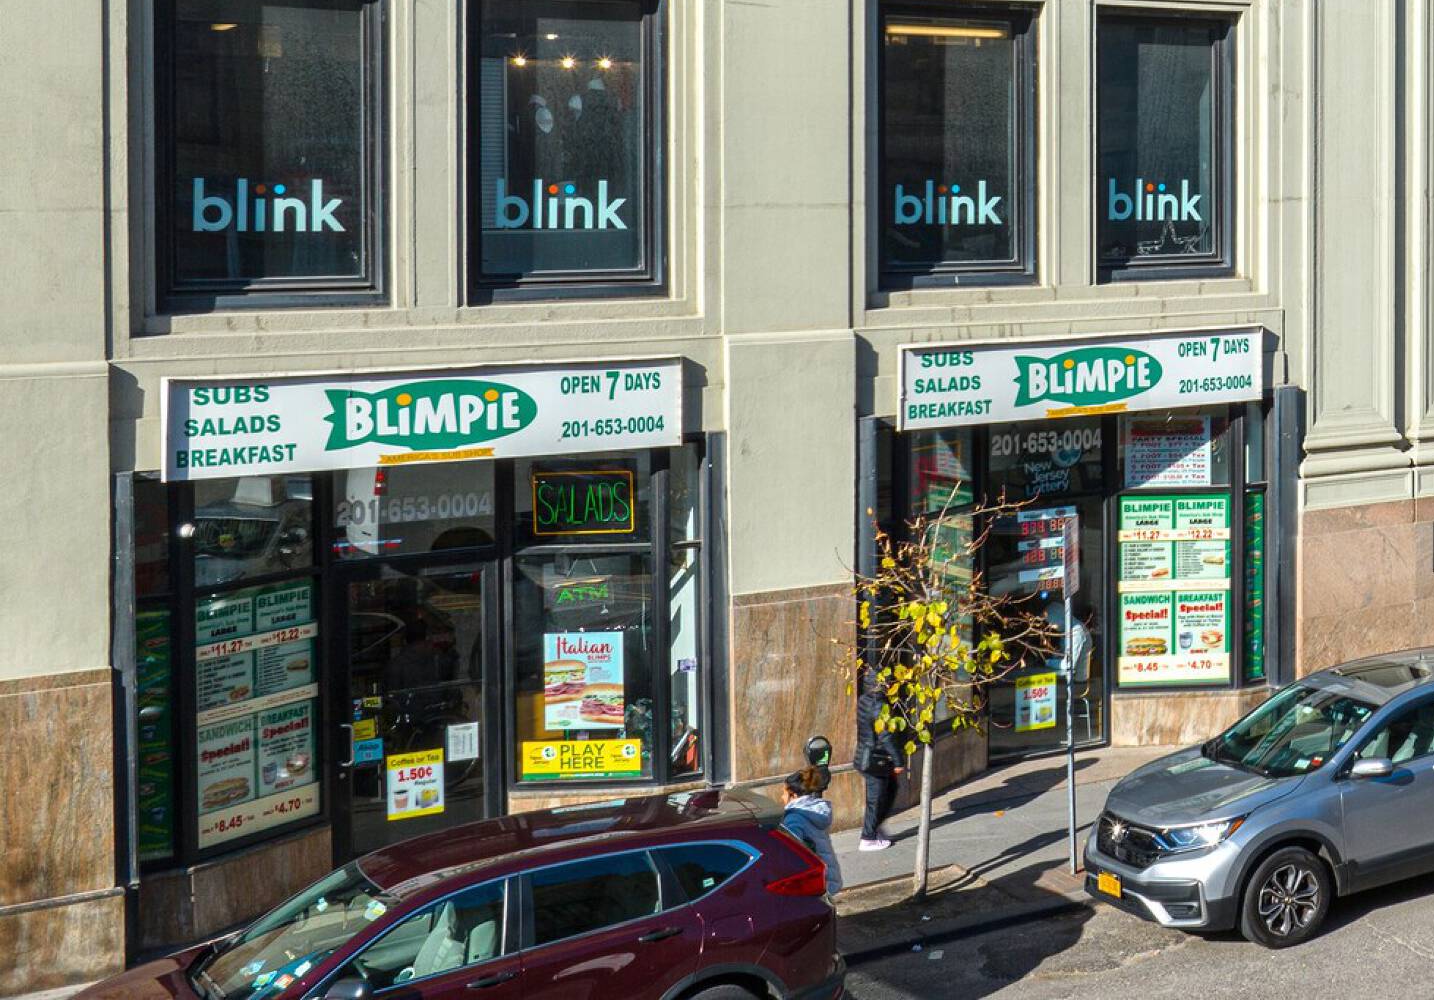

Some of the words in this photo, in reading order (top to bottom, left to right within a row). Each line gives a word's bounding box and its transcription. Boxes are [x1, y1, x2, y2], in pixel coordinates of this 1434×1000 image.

[191, 177, 347, 233] blink
[494, 178, 628, 229] blink
[894, 179, 1003, 225] blink
[1107, 177, 1202, 222] blink
[921, 350, 974, 368] SUBS
[1178, 341, 1207, 358] OPEN
[1210, 337, 1221, 362] 7
[1224, 338, 1250, 355] DAYS
[193, 384, 270, 405] SUBS
[561, 375, 600, 395] OPEN
[606, 371, 620, 400] 7
[625, 372, 661, 391] DAYS
[914, 375, 981, 394] SALADS
[1179, 374, 1252, 394] 201-653-0004
[907, 399, 993, 420] BREAKFAST
[183, 414, 281, 437] SALADS
[562, 415, 665, 438] 201-653-0004
[991, 428, 1102, 456] 201-653-0004
[176, 443, 297, 468] BREAKFAST
[335, 492, 491, 527] 201-653-0004
[537, 482, 631, 525] SALADS
[1124, 503, 1171, 513] BLIMPIE
[1177, 501, 1224, 510] BLIMPIE
[1124, 594, 1170, 605] SANDWICH
[1177, 593, 1223, 603] BREAKFAST
[556, 635, 613, 660] Italian
[390, 758, 414, 767] Coffee
[427, 754, 439, 762] Tea
[560, 743, 605, 756] PLAY
[560, 756, 605, 769] HERE
[397, 766, 433, 783] 1.50¢
